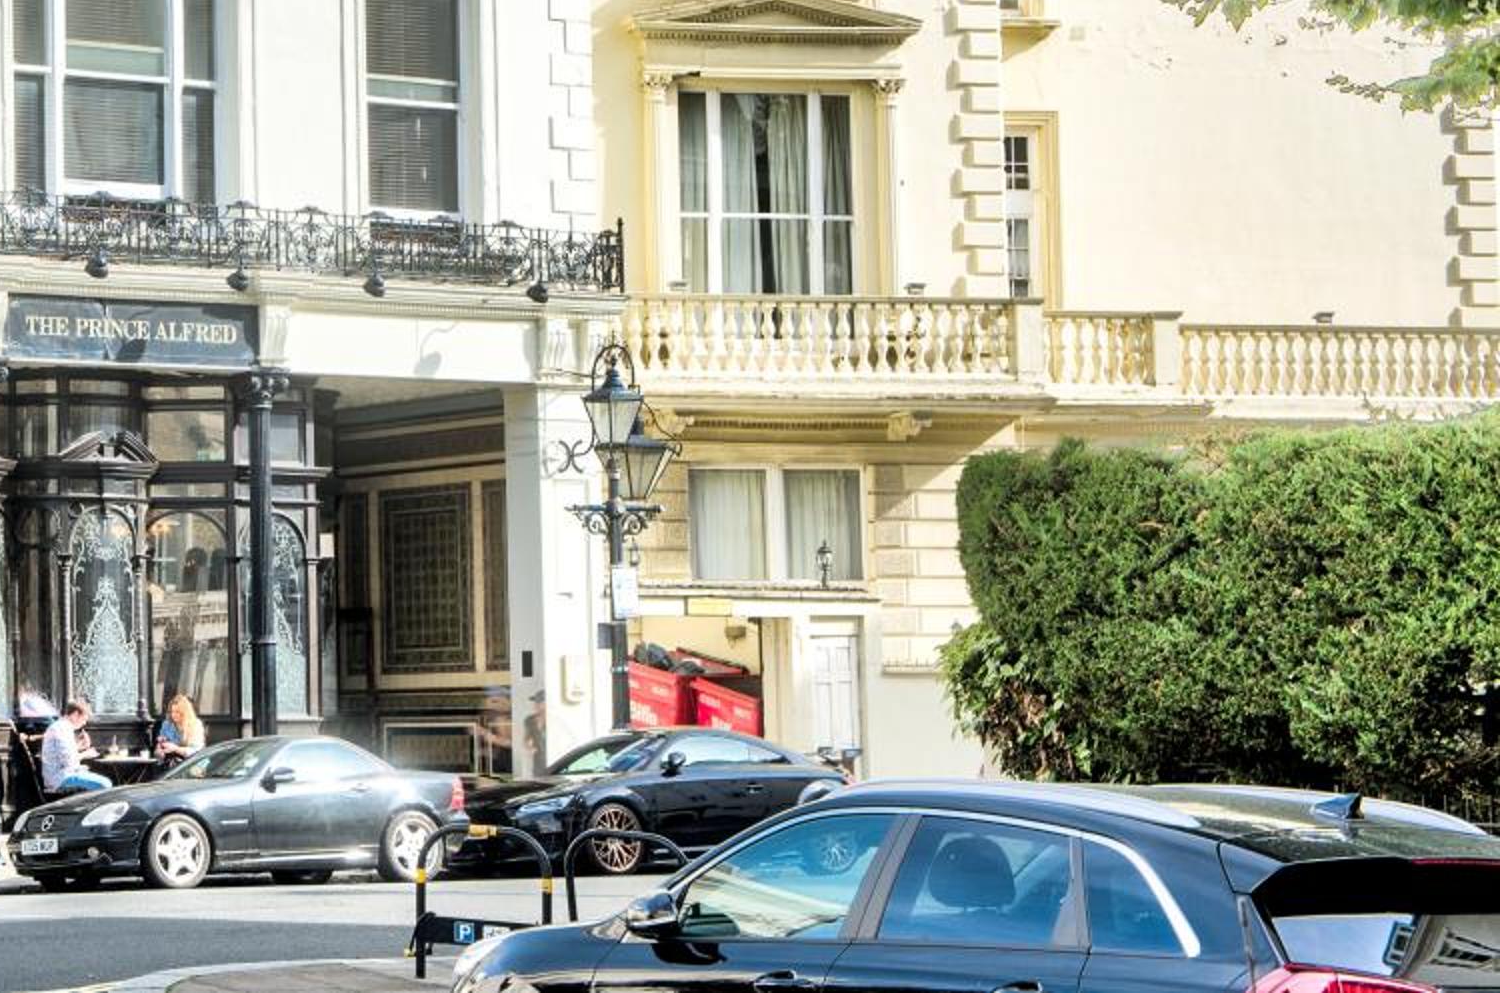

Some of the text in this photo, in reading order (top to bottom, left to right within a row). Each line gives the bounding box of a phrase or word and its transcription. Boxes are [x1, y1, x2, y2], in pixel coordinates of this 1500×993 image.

[25, 315, 238, 345] THE PRINCE ALFRED
